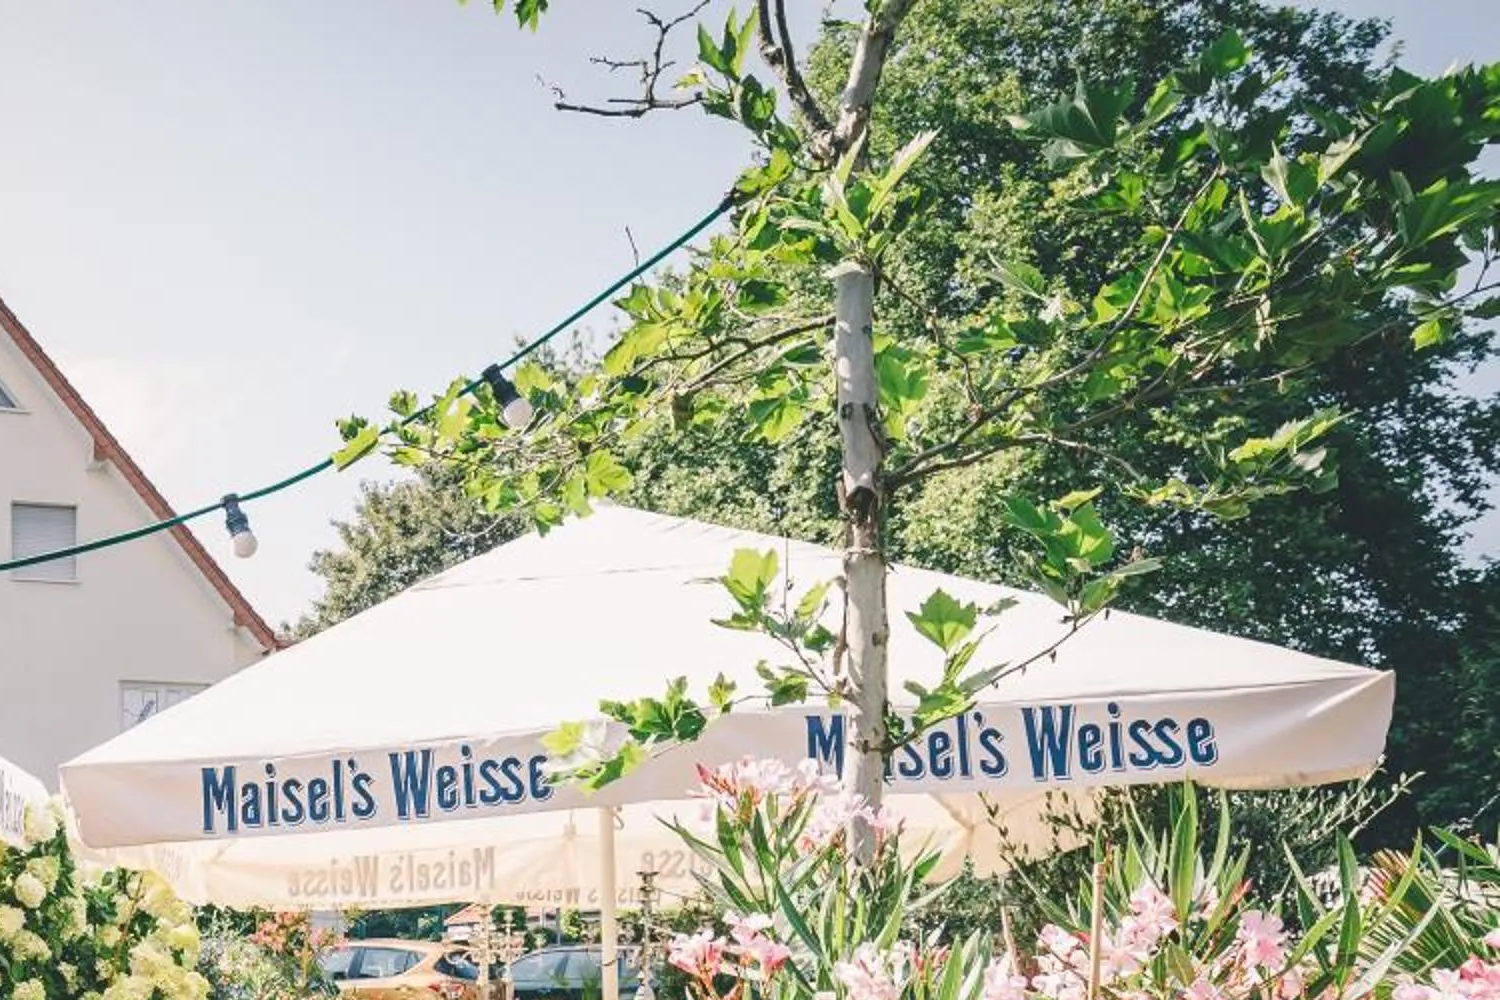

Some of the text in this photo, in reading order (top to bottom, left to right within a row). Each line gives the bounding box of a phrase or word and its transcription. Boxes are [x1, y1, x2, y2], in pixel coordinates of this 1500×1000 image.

[805, 701, 1219, 782] Msel's Weisse
[202, 745, 554, 832] Maisel's Weisse
